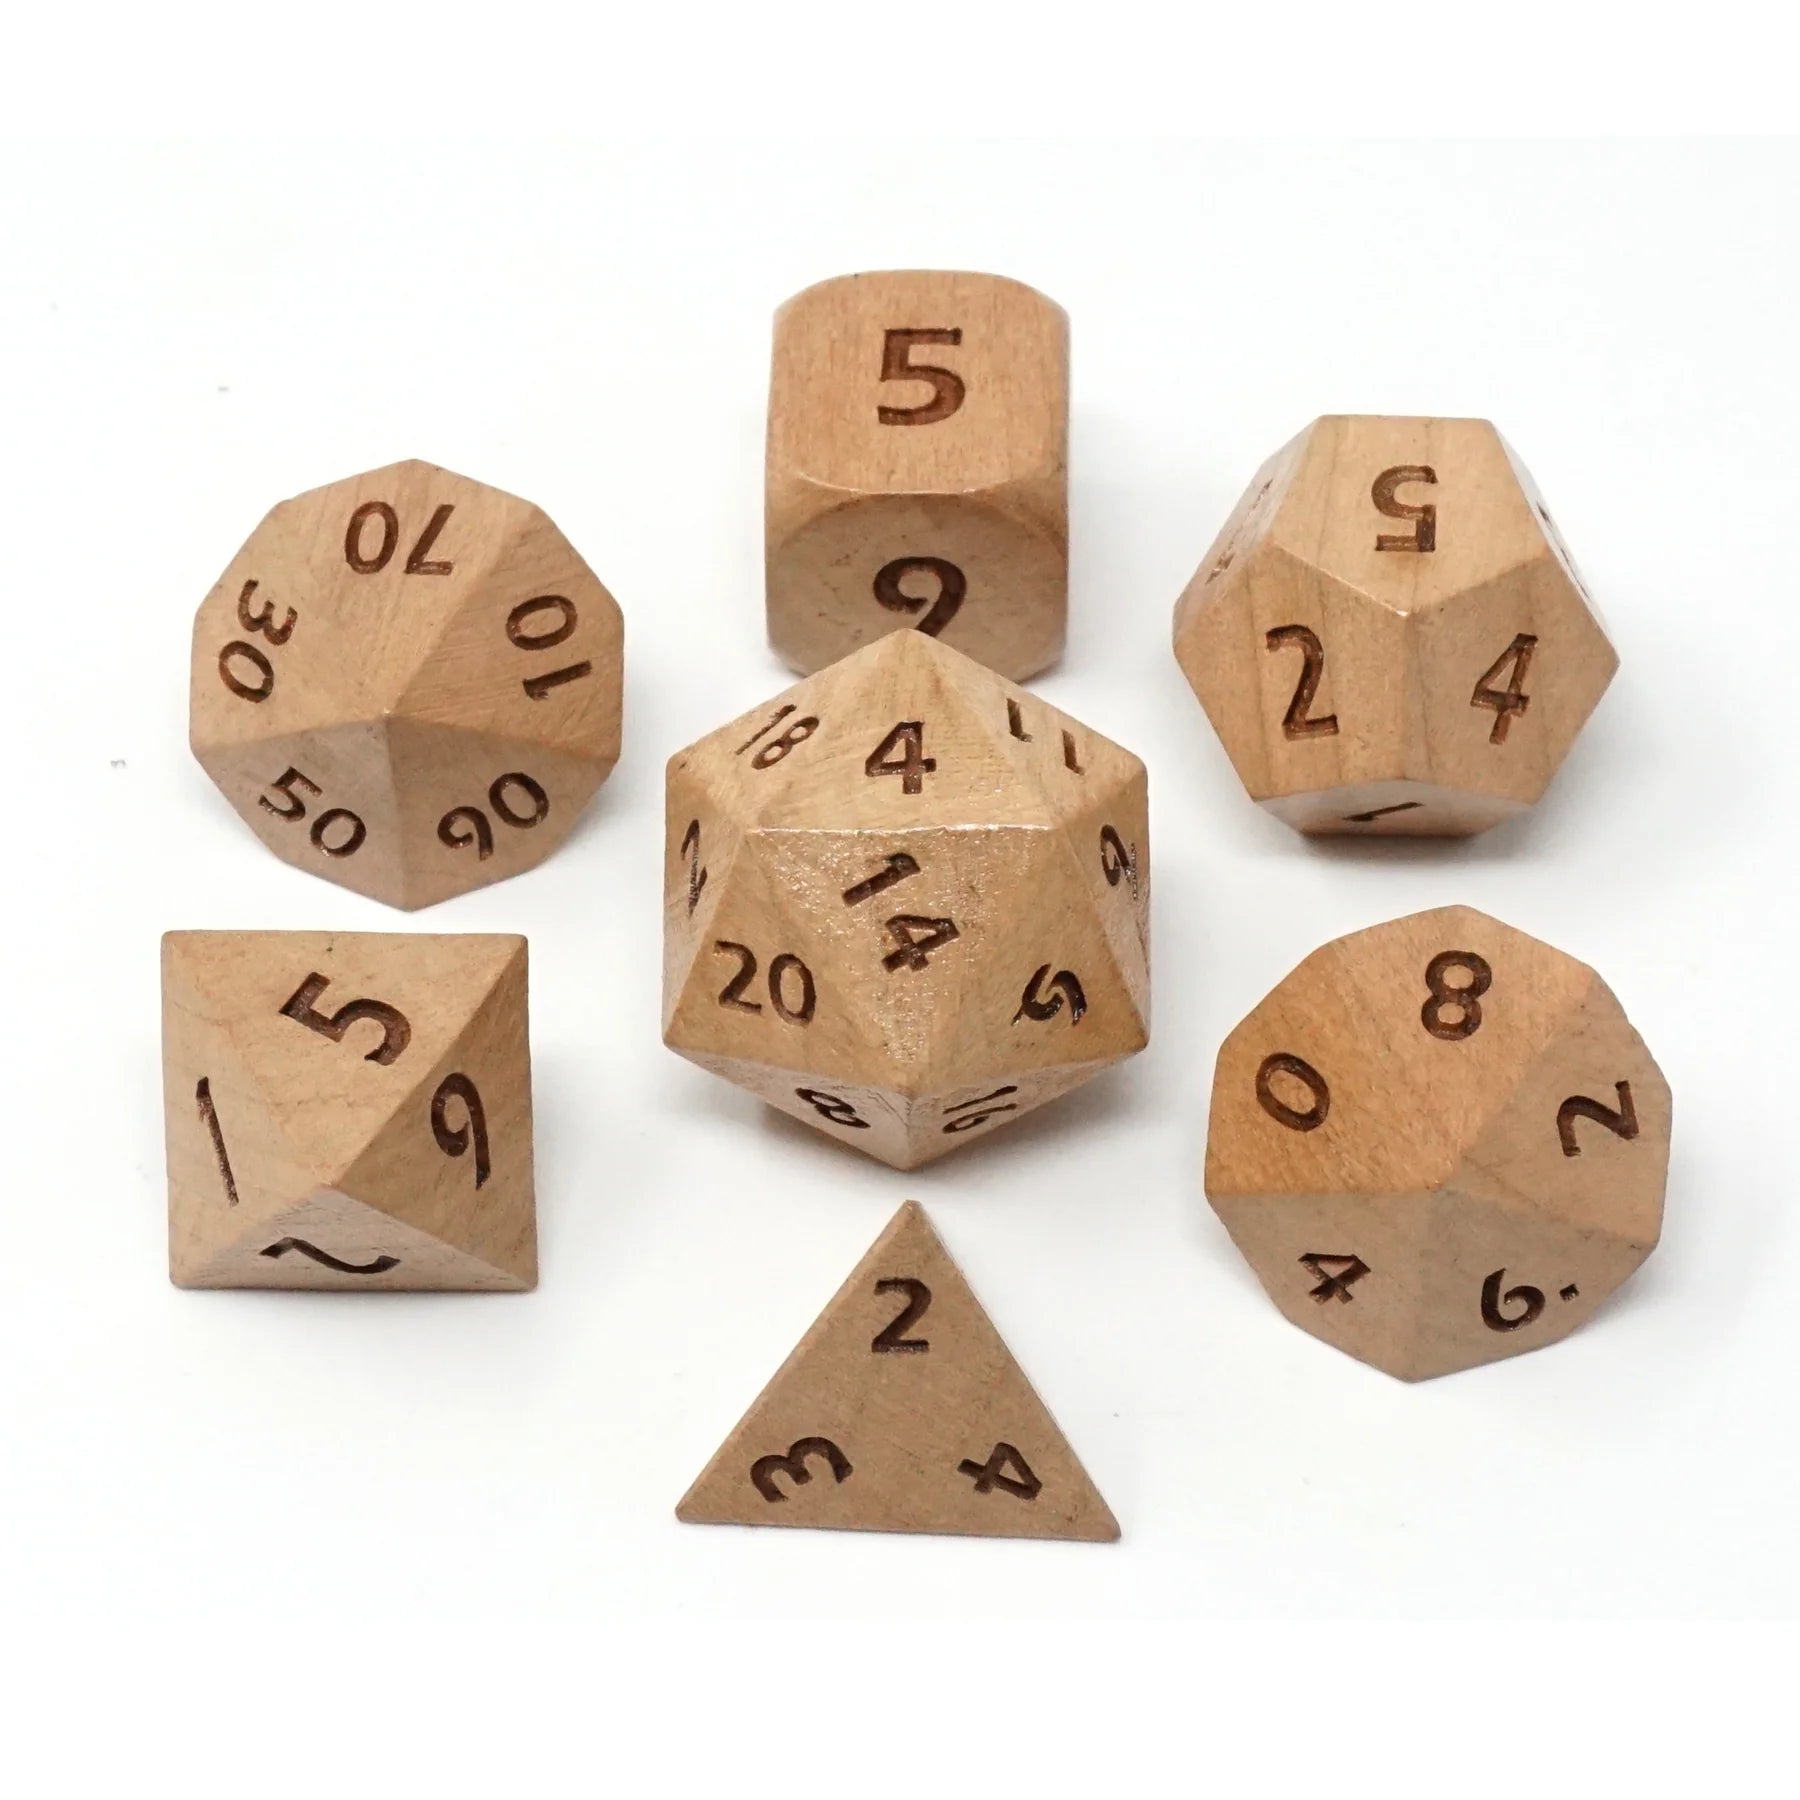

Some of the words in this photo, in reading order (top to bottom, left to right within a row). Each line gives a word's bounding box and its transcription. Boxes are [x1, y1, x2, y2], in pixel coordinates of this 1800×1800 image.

[877, 327, 966, 426] 5
[344, 501, 455, 576] 70
[1371, 465, 1438, 552] 5
[218, 579, 298, 704] 30
[506, 594, 593, 701] 10
[1265, 623, 1340, 742] 2
[1469, 632, 1539, 746] 4
[735, 704, 820, 770] 18
[865, 720, 937, 795] 4
[1006, 697, 1086, 775] 11
[258, 766, 367, 859] 50
[436, 772, 550, 861] 90
[842, 852, 960, 973] 14
[278, 971, 412, 1066] 5
[713, 939, 817, 1027] 20
[1420, 950, 1493, 1041] 8
[795, 1087, 871, 1129] 8
[942, 1085, 1019, 1134] 16
[1255, 1052, 1331, 1133] 0
[1556, 1080, 1640, 1158] 2
[195, 1075, 240, 1207] 1
[870, 1276, 933, 1354] 2
[1297, 1252, 1372, 1305] 4
[749, 1436, 854, 1503] 3
[956, 1441, 1043, 1501] 4
